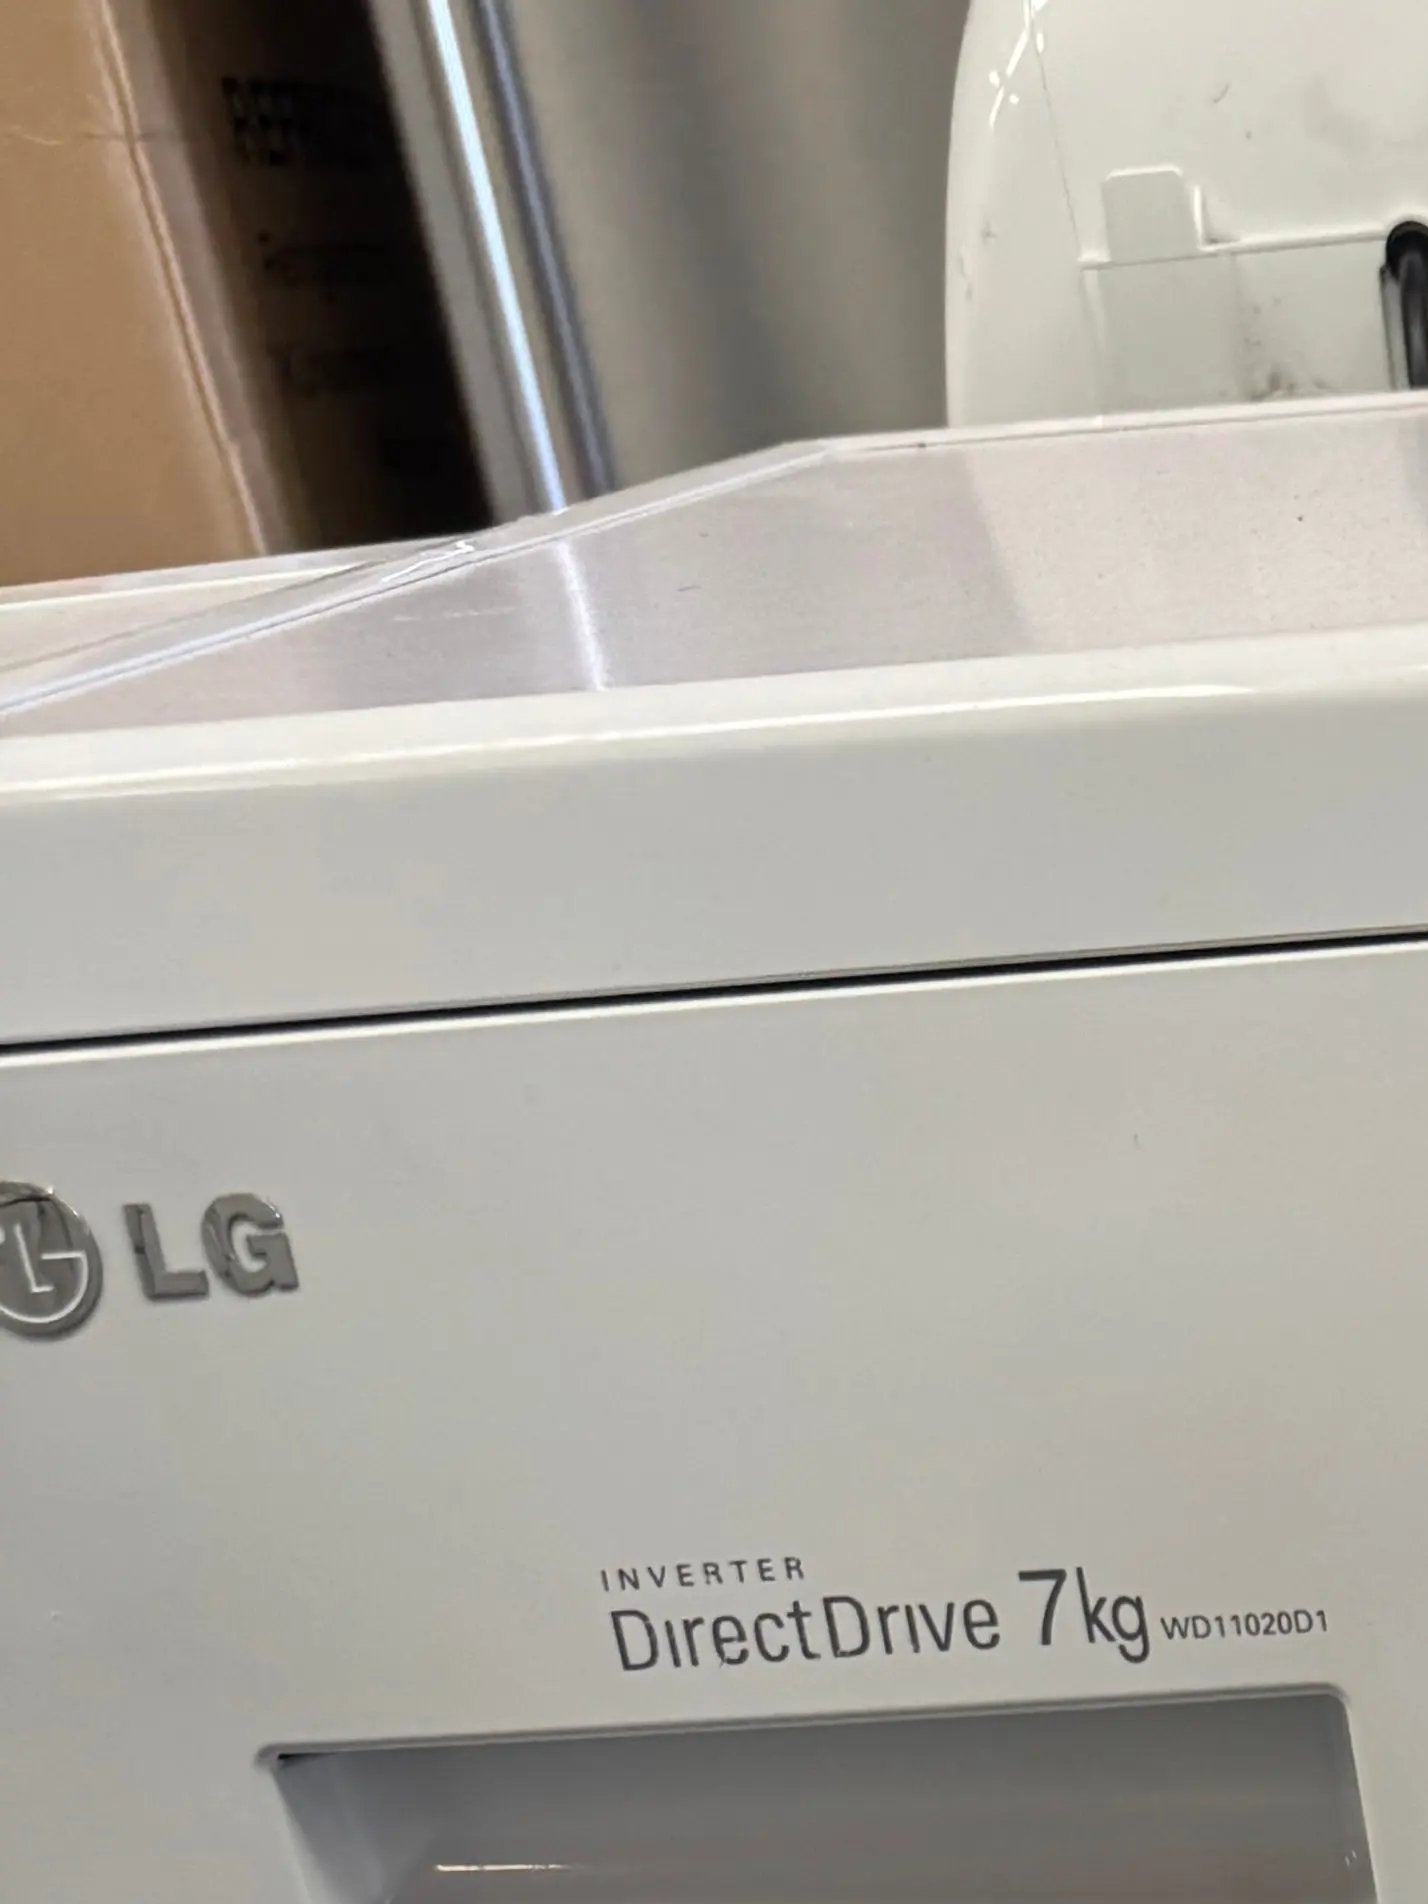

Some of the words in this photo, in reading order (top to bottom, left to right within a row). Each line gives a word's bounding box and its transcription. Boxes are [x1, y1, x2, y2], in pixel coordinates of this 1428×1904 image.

[123, 1193, 300, 1303] LG
[600, 1554, 806, 1594] INVERTER
[1016, 1564, 1154, 1664] 7kg
[1159, 1606, 1331, 1643] WD11020D1
